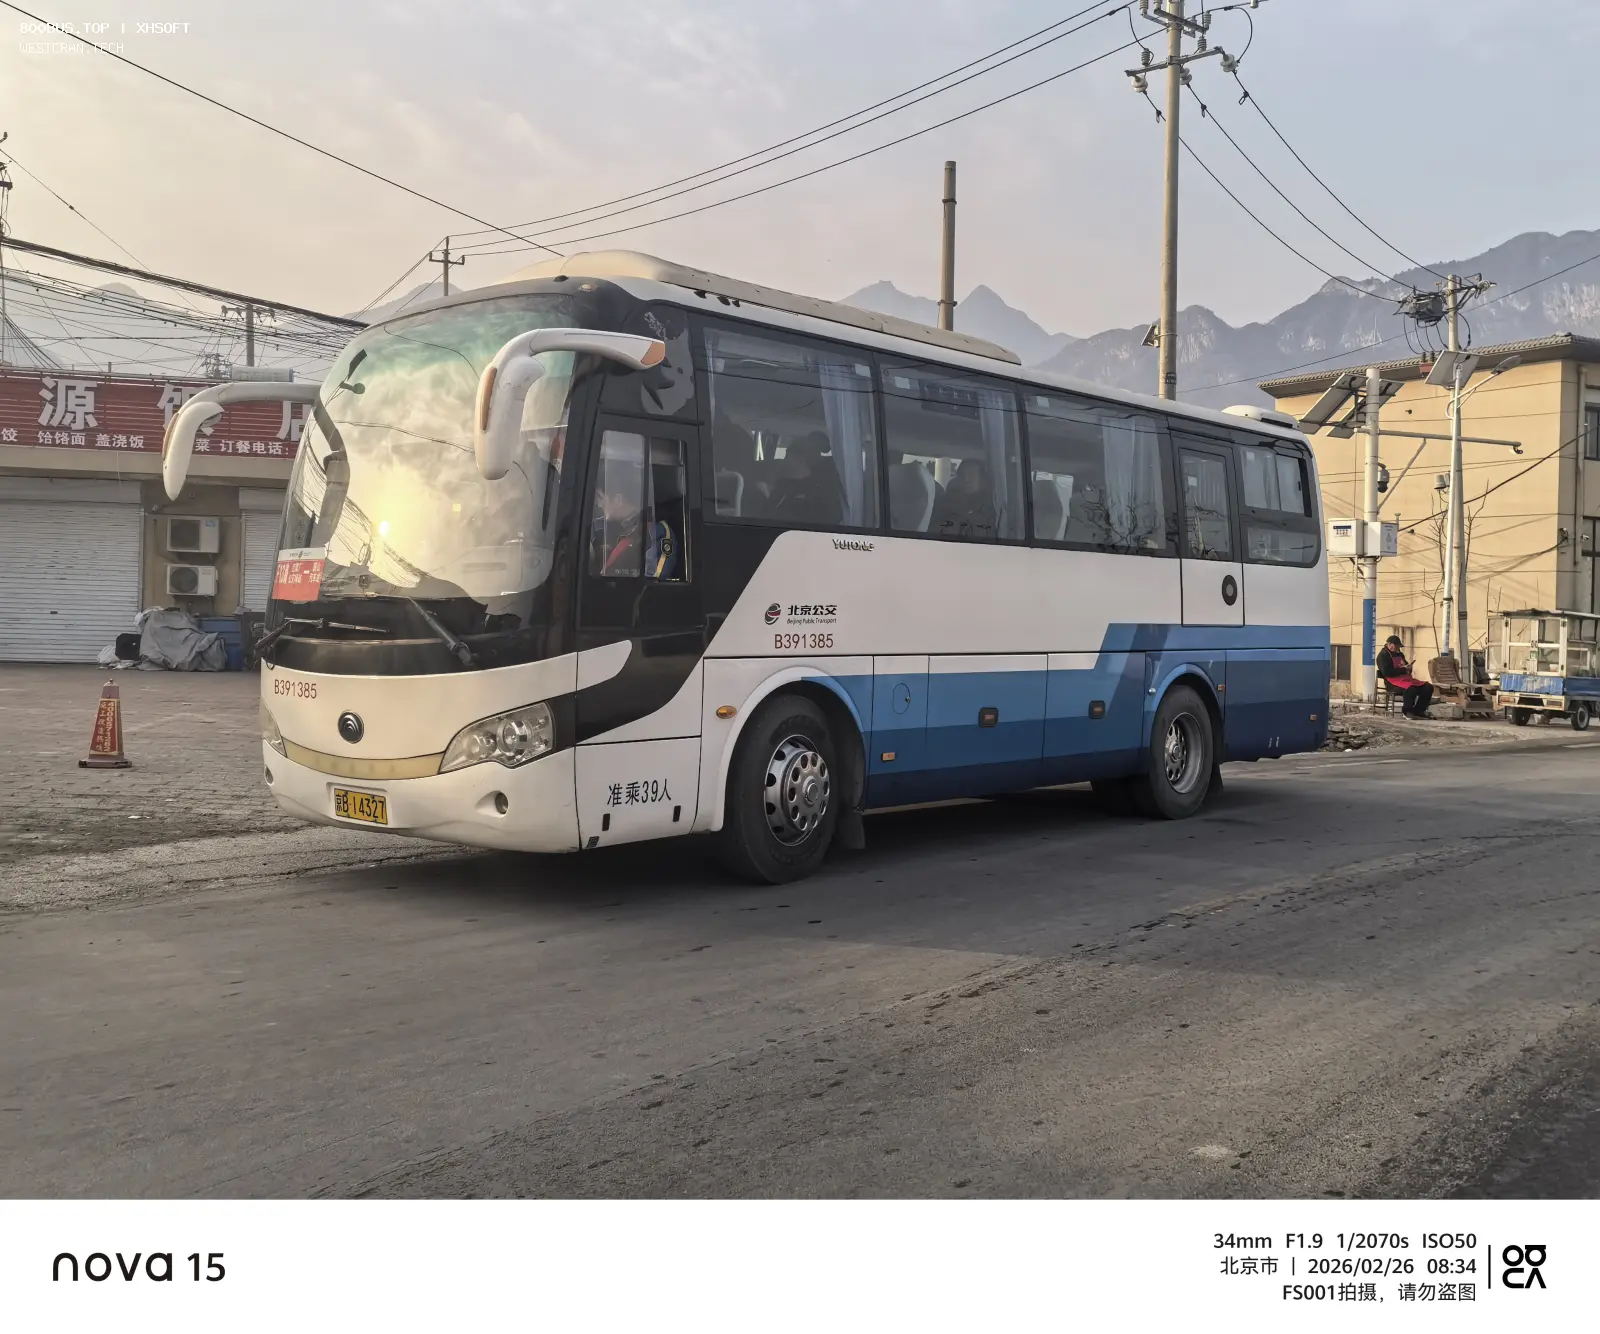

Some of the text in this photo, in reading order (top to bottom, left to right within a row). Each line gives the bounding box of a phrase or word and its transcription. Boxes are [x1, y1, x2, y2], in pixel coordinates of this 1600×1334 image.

[38, 376, 99, 430] 源
[95, 433, 145, 449] 盖浇饭
[787, 604, 838, 616] 北京公交
[774, 633, 834, 649] B391385
[274, 679, 318, 699] B391385
[607, 779, 671, 807] 准乘39人
